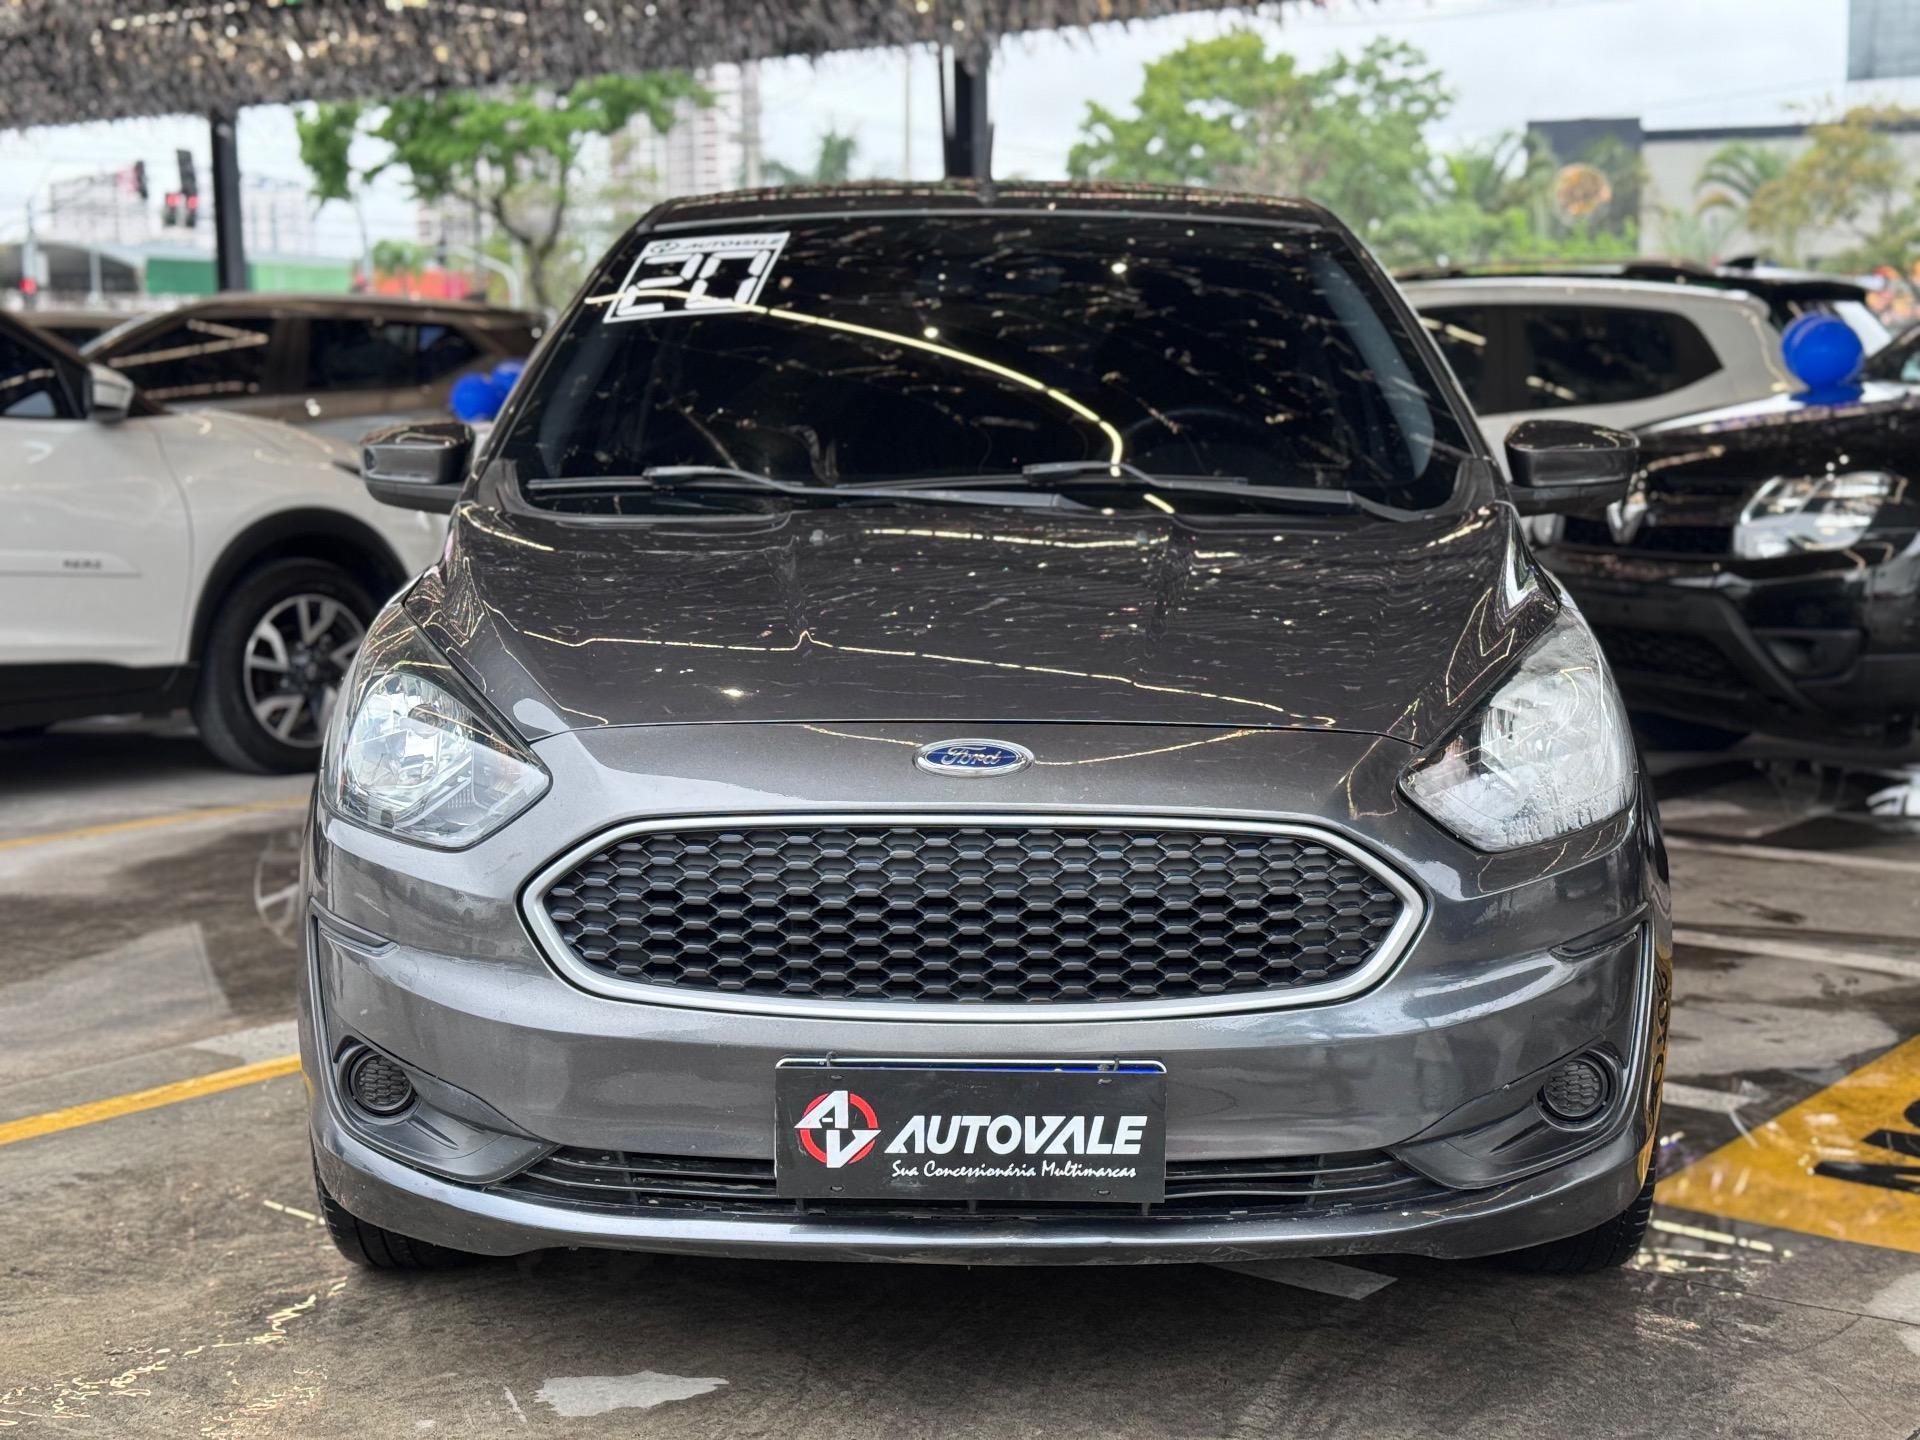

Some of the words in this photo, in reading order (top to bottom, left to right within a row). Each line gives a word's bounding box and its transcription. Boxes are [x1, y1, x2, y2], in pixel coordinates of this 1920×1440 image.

[616, 250, 771, 317] 20
[941, 746, 1002, 765] Ford
[884, 1114, 1148, 1155] AUTOVALE
[892, 1160, 919, 1177] Sua
[924, 1160, 1036, 1177] Concessionária
[1041, 1160, 1137, 1178] Multimarcas
